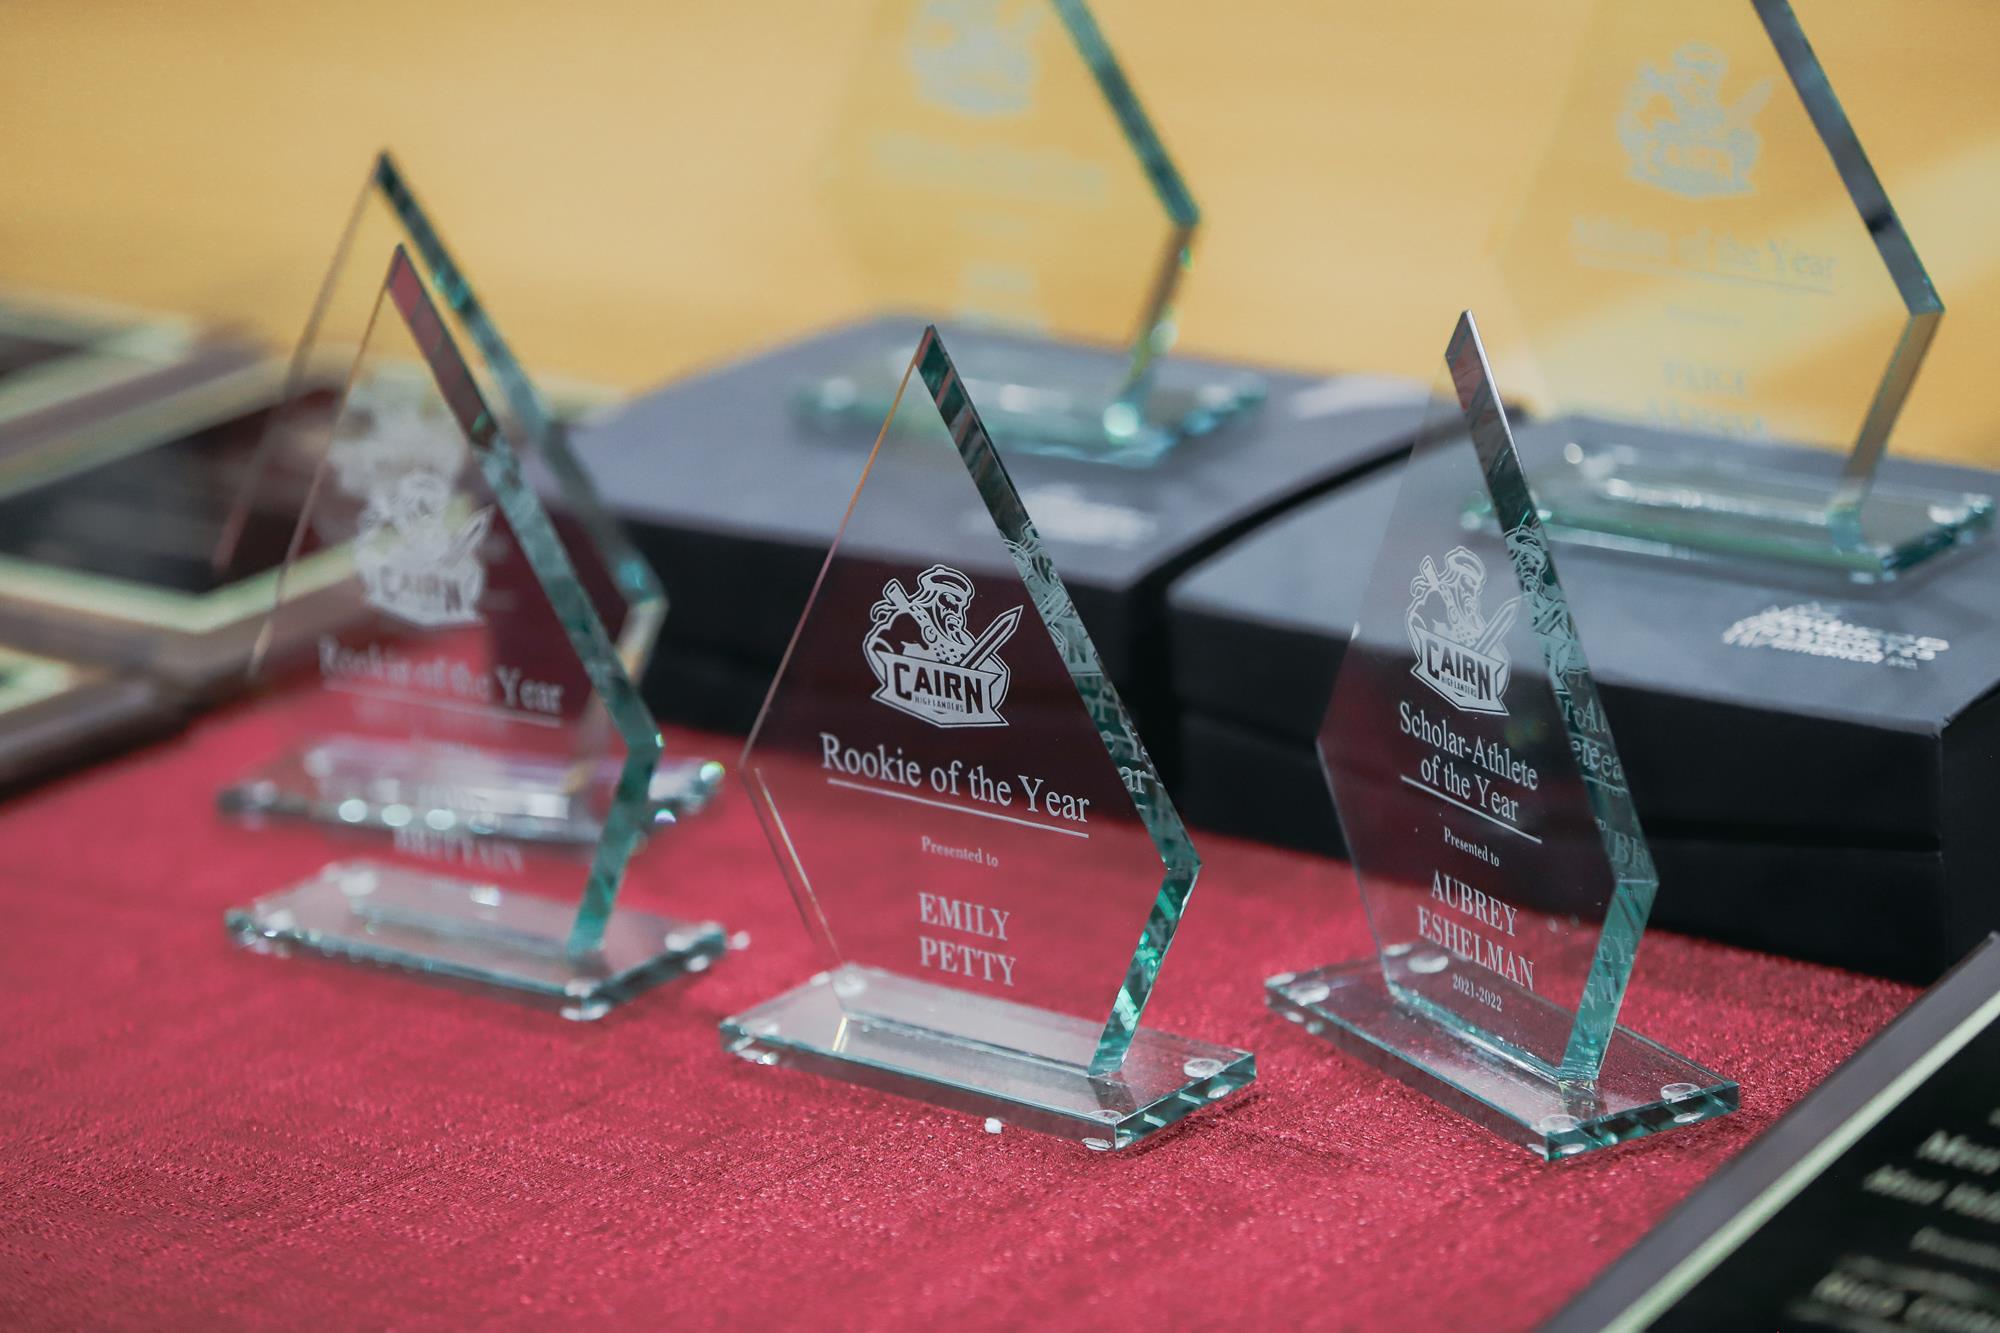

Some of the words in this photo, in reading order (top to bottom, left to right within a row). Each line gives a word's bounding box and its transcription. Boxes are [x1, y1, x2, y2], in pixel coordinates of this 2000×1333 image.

[495, 665, 565, 714] Year
[893, 661, 984, 714] CAIRN
[1426, 638, 1492, 701] CAIRN
[1400, 700, 1538, 791] Scholar-Athlete
[819, 732, 922, 788] Rookie
[930, 759, 962, 796] of
[967, 764, 1012, 807] the
[1017, 773, 1090, 823] Year
[1420, 755, 1441, 786] of
[1443, 762, 1471, 800] the
[1473, 773, 1519, 822] Year
[921, 834, 983, 864] Presented
[986, 852, 999, 868] to
[1443, 826, 1488, 862] Presented
[1490, 850, 1500, 867] to
[918, 891, 1010, 941] EMILY
[1431, 869, 1518, 937] AUBREY
[918, 935, 1017, 986] PETTY
[1417, 905, 1535, 992] ESHELMAN
[1451, 974, 1503, 1013] 2021-2022
